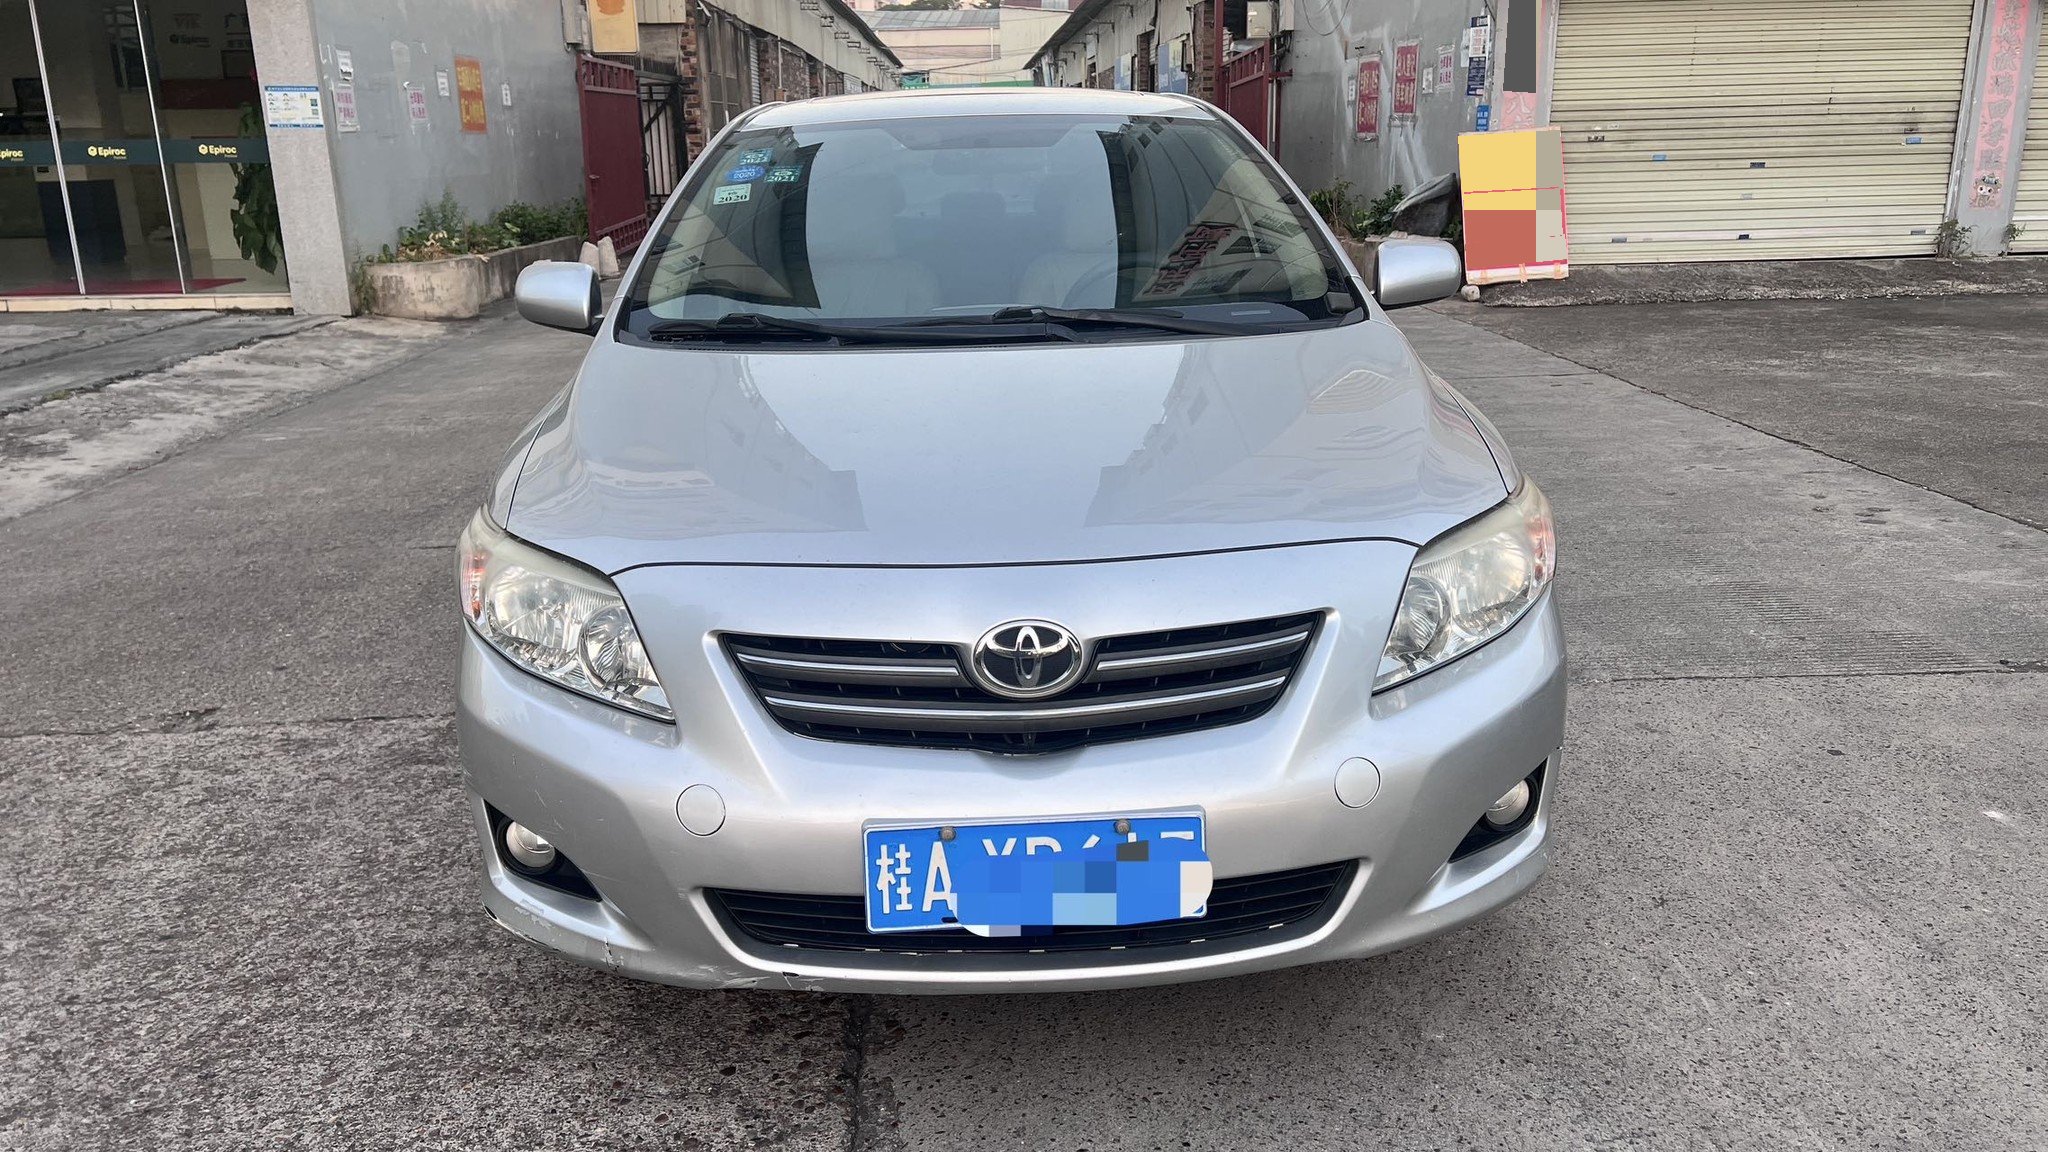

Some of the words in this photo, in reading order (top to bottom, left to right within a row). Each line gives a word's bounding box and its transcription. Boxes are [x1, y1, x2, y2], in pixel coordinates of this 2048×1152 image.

[0, 149, 23, 159] piroc
[98, 147, 126, 157] Epiroc
[209, 145, 237, 156] Epiroc
[740, 157, 768, 165] 2022
[733, 171, 755, 179] 2020
[718, 194, 747, 203] 2020
